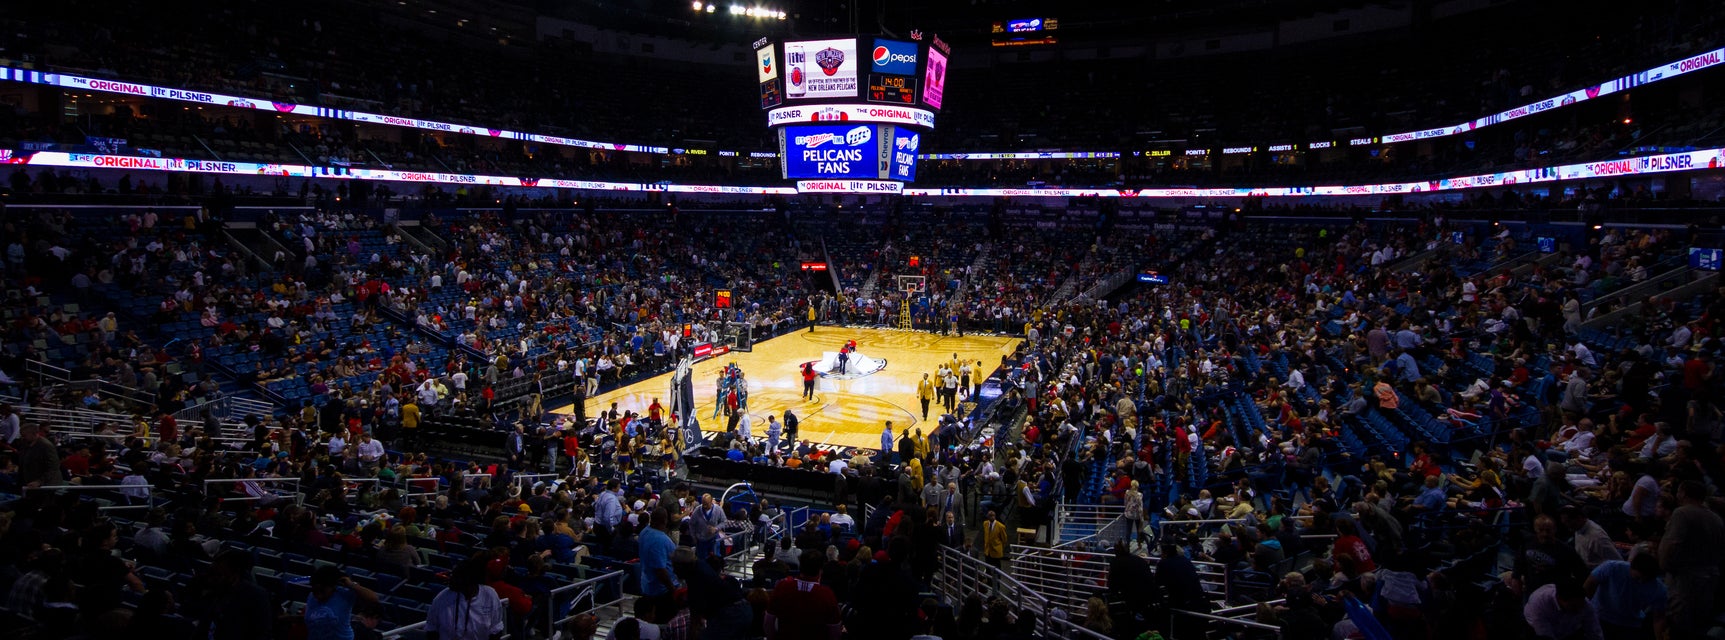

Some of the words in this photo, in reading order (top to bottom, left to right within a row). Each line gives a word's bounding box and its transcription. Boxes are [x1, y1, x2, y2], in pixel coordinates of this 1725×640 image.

[788, 52, 804, 66] Lite
[890, 53, 916, 63] pepsi
[1680, 52, 1720, 72] ORIGINAL
[885, 77, 904, 87] 14:00
[89, 80, 147, 95] ORIGINAL
[170, 90, 214, 103] PILSNER.
[870, 109, 911, 120] ORIGINAL
[1508, 107, 1527, 119] ORIGINAL
[384, 117, 415, 127] ORIGINAL
[881, 127, 889, 158] Chevron
[803, 149, 862, 161] PELICANS
[896, 152, 914, 166] PELICANS
[94, 156, 160, 169] ORIGINAL
[818, 162, 850, 174] FANS
[1594, 160, 1632, 175] ORIGINAL
[1651, 154, 1694, 170] PILSNER.
[401, 172, 435, 181] ORIGINAL
[898, 164, 910, 177] FANS
[806, 182, 846, 190] ORIGINAL
[850, 181, 864, 192] Lite
